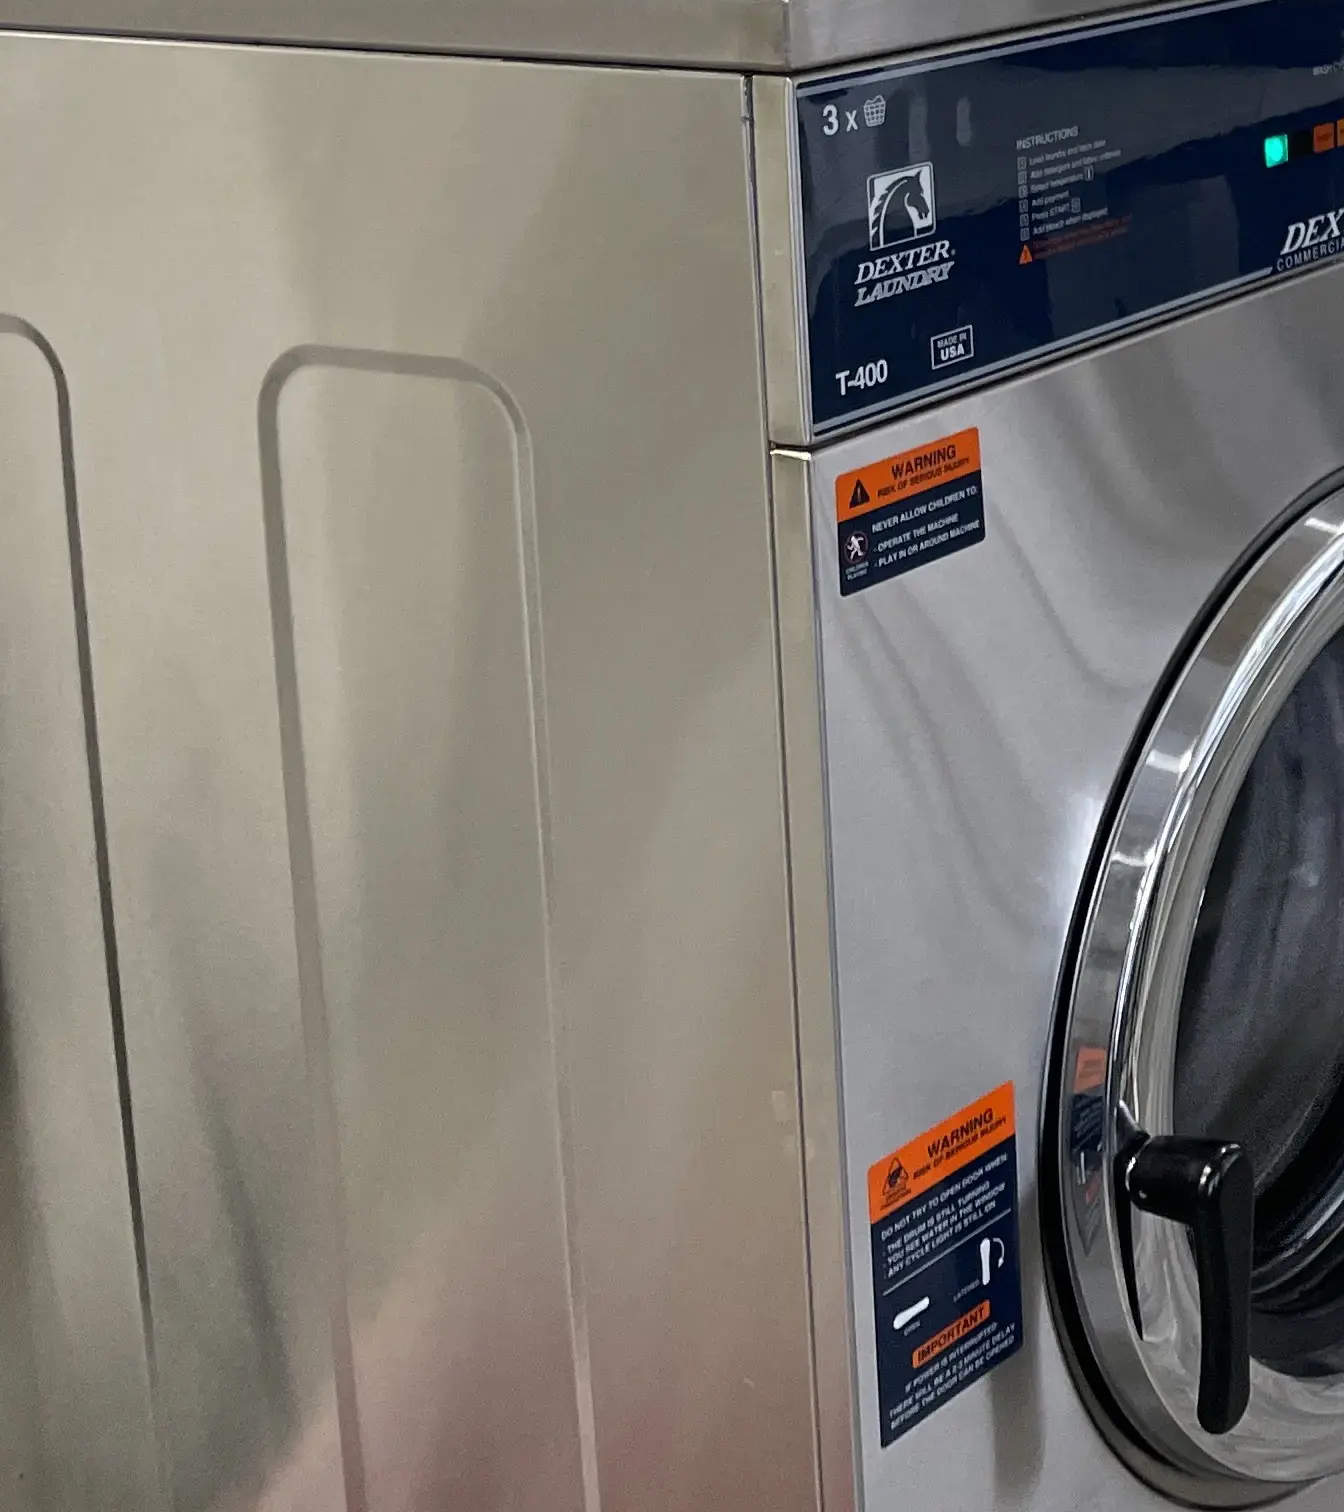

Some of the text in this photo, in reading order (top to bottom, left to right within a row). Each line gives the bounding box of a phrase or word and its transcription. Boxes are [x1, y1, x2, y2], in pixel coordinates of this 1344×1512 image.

[822, 104, 858, 135] 3 x
[1016, 125, 1078, 150] INSTRUCTIONS
[855, 239, 950, 285] DEXTER
[855, 261, 955, 307] LAUNDRY
[940, 343, 965, 361] USA
[836, 359, 888, 396] T-400
[891, 444, 955, 480] WARNING
[872, 514, 898, 533] NEVER
[900, 504, 926, 522] ALLOW
[928, 490, 965, 512] CHILDREN
[877, 513, 958, 552] OPERATE THE MACHINE
[878, 552, 897, 567] PLAY
[907, 544, 918, 555] OR
[919, 533, 948, 551] AROUND
[927, 1107, 992, 1158] WARNING
[881, 1225, 892, 1240] DO
[894, 1215, 909, 1231] NOT
[912, 1204, 925, 1219] TRY
[928, 1195, 938, 1209] TO
[940, 1182, 960, 1202] OPEN
[887, 1237, 901, 1253] THE
[935, 1203, 954, 1222] STILL
[888, 1260, 903, 1276] ANY
[963, 1208, 982, 1227] STILL
[888, 1248, 904, 1266] YOU
[921, 1219, 947, 1242] WATER
[917, 1306, 983, 1362] IMPORTANT
